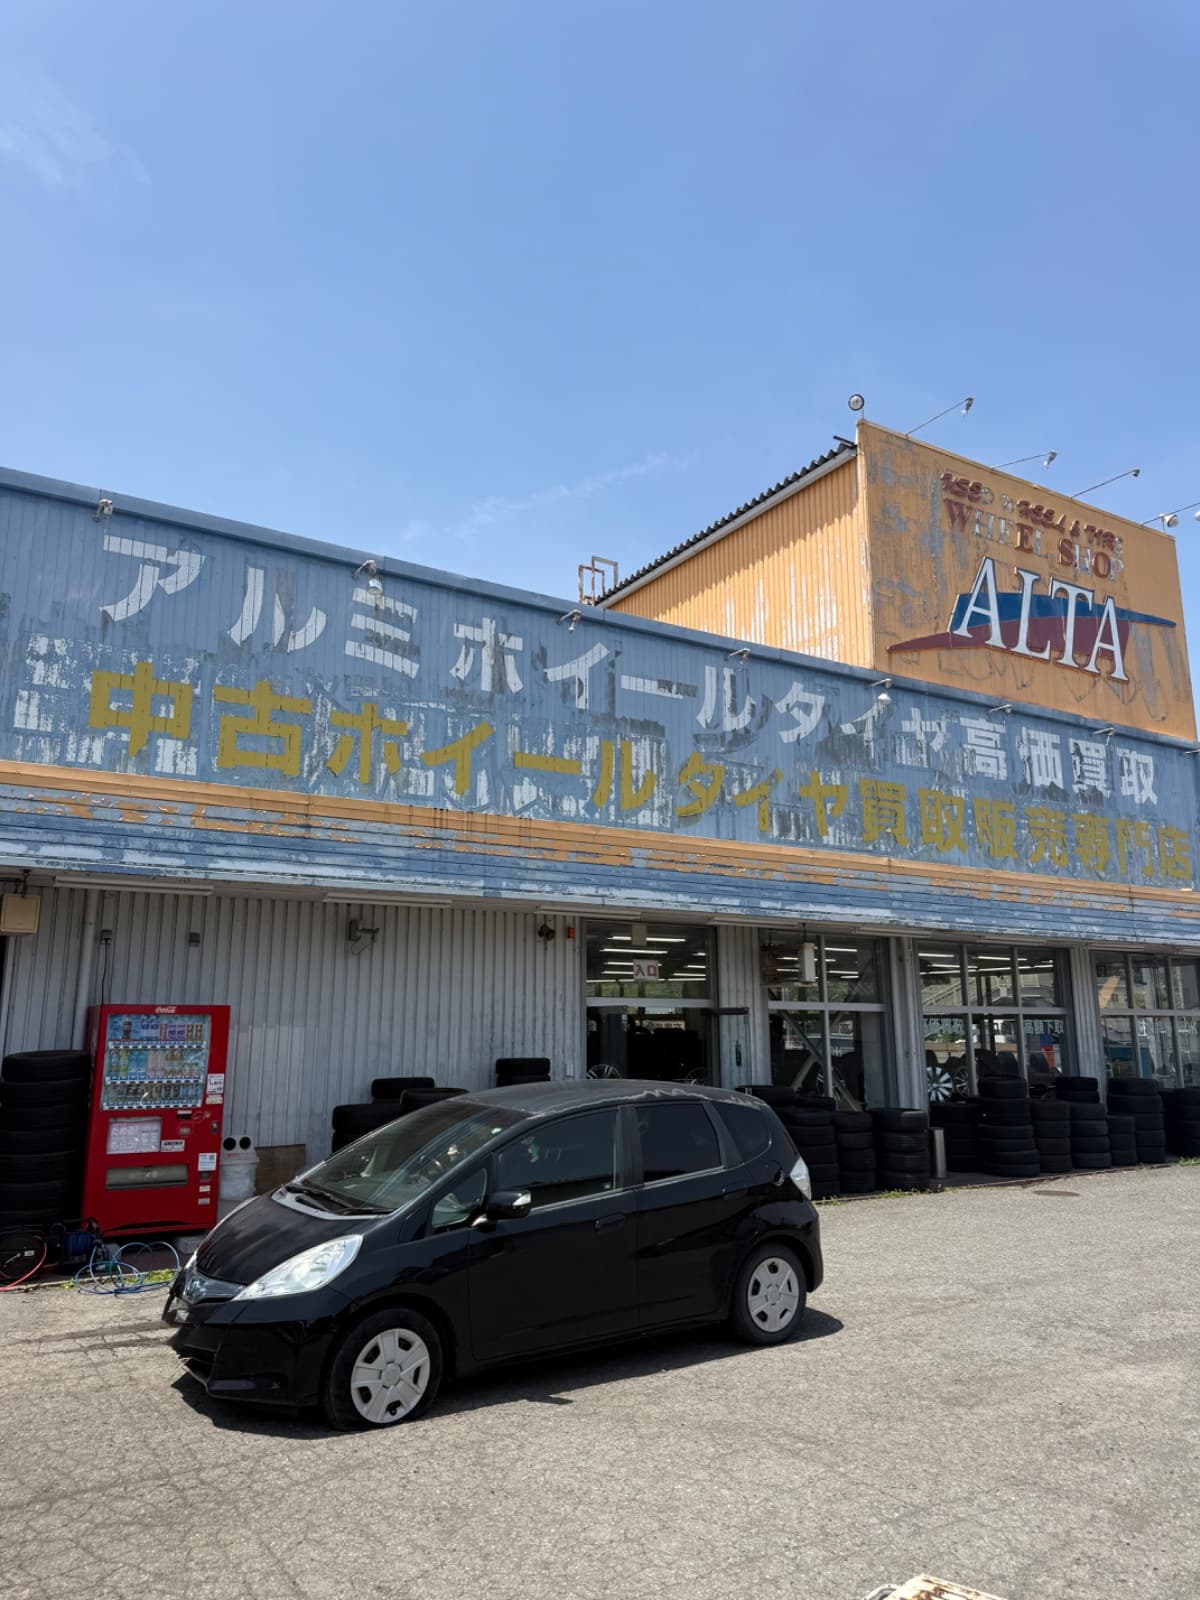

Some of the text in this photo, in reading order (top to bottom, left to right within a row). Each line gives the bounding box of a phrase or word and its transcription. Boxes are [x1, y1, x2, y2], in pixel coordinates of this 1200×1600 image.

[1059, 537, 1124, 581] SHOP
[950, 556, 1129, 682] ALTA
[635, 964, 657, 977] 入口
